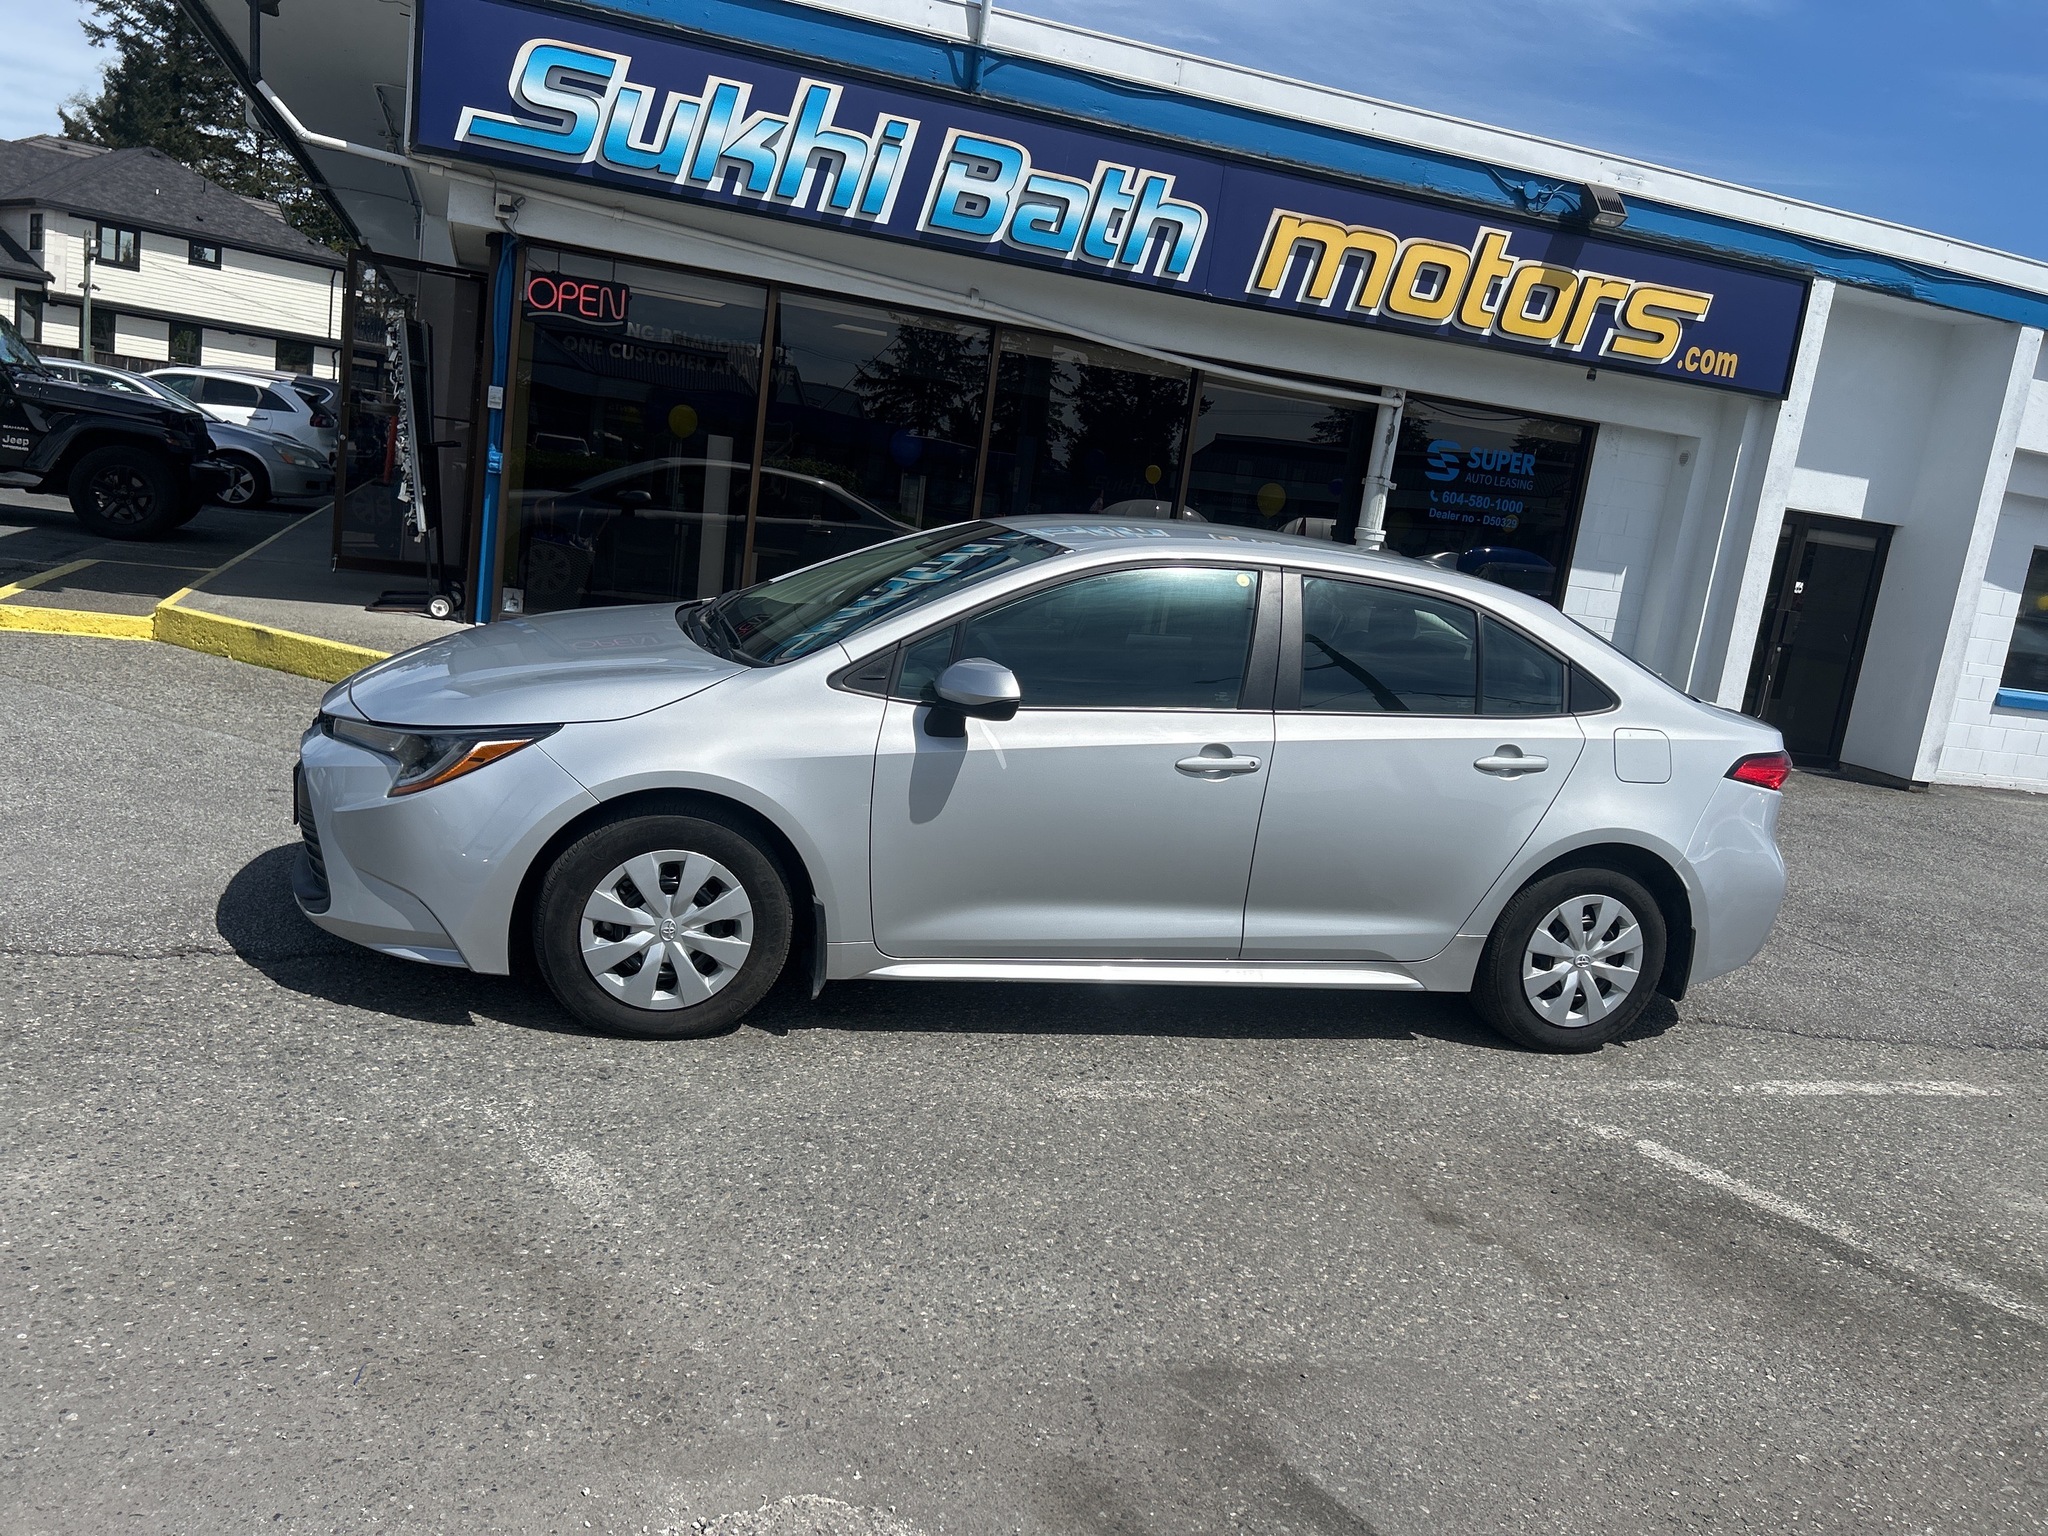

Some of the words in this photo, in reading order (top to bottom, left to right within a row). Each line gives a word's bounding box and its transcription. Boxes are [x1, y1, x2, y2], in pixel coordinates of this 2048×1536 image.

[454, 38, 920, 225] Sukhi
[915, 127, 1209, 283] Bath
[527, 277, 626, 320] OPEN
[562, 334, 605, 356] ONE
[608, 342, 709, 372] CUSTOMER
[2, 434, 30, 447] Jeep
[1466, 446, 1536, 476] SUPER
[1465, 472, 1492, 486] AUTO
[1494, 476, 1534, 491] LEASING
[1429, 507, 1460, 522] Dealer
[1462, 514, 1475, 523] no
[1442, 491, 1524, 514] 604-580-1000
